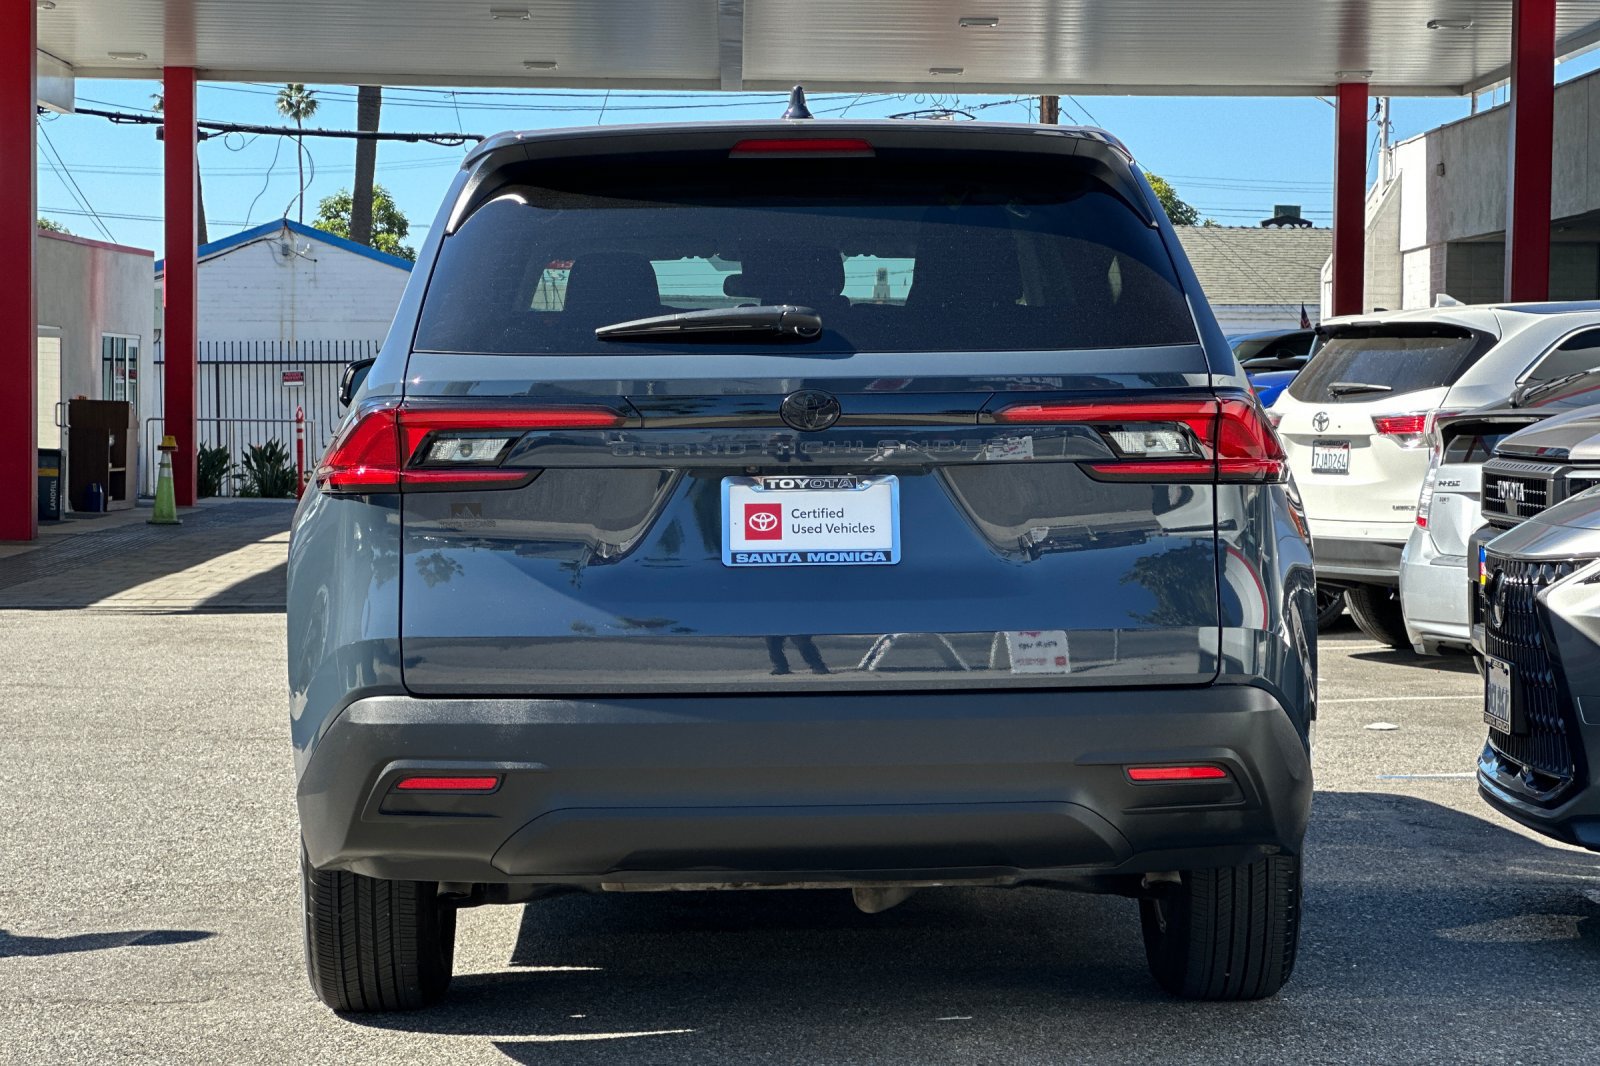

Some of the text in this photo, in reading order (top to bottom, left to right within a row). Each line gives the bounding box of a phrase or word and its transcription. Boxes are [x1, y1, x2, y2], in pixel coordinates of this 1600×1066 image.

[766, 478, 853, 489] TOYOTA
[1497, 480, 1524, 501] TOYOTA
[791, 508, 844, 519] Certified
[791, 523, 875, 534] Used Vehicles
[736, 552, 887, 563] SANTA MONICA
